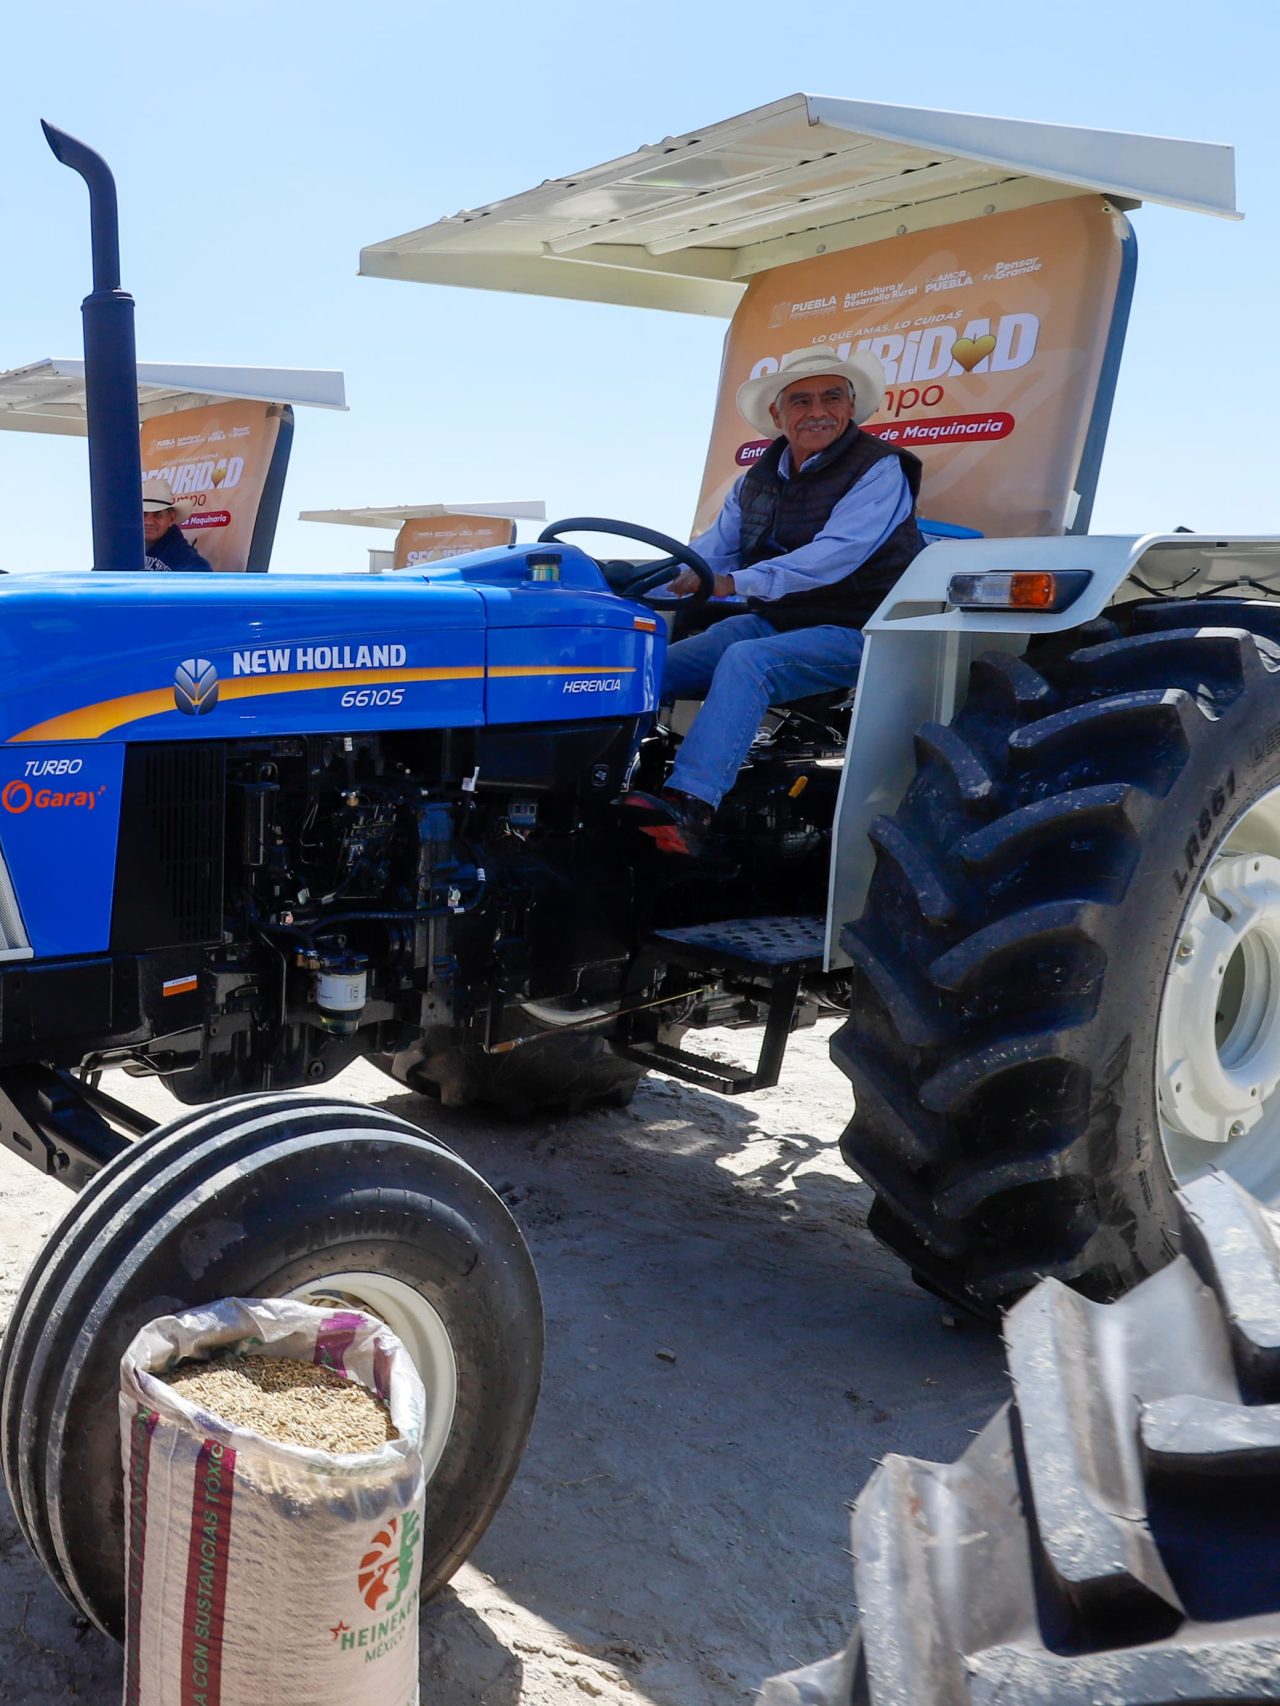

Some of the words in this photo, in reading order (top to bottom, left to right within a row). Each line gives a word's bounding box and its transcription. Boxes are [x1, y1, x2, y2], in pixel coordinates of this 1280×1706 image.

[995, 257, 1040, 271] Pensar
[996, 264, 1042, 280] Grande
[844, 285, 896, 300] Agricultura
[925, 277, 974, 293] PUEBLA
[792, 296, 837, 313] PUEBLA
[843, 291, 890, 308] Desarrollo
[892, 286, 918, 298] Rural
[812, 335, 827, 344] LO
[829, 331, 853, 341] QUE
[894, 321, 911, 330] LO
[914, 309, 964, 326] CUIDAS
[879, 427, 900, 440] de
[903, 419, 1003, 440] Maquinaria
[190, 514, 227, 526] Maquinaria
[233, 649, 291, 675] NEW
[296, 644, 407, 671] HOLLAND
[562, 678, 621, 693] HERENCIA
[340, 689, 406, 708] 6610S
[24, 759, 83, 776] TURBO
[194, 1512, 218, 1638] SUSTANCIAS
[192, 1643, 210, 1688] CON
